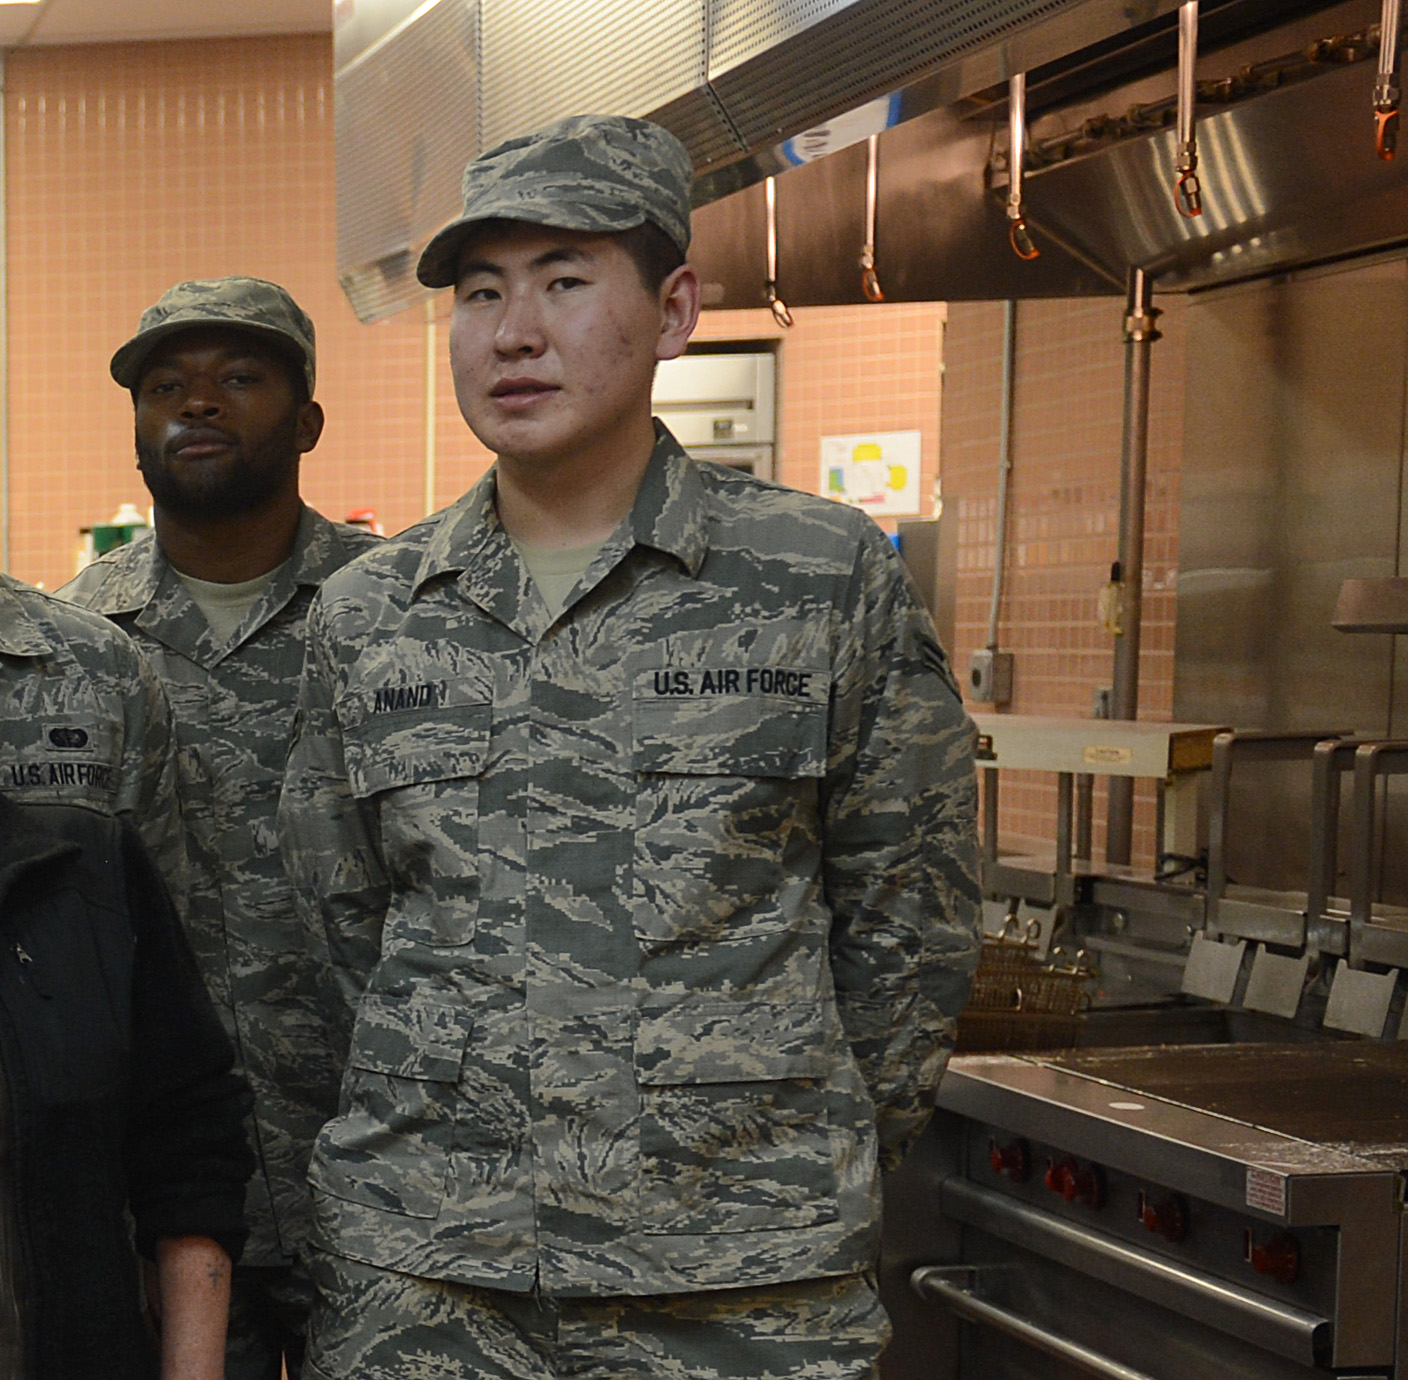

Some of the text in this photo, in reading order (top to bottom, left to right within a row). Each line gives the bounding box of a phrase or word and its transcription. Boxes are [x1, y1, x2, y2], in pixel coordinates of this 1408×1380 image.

[654, 669, 812, 697] U.S. AIR FORCE
[11, 763, 113, 789] U.S. AIR FORCE
